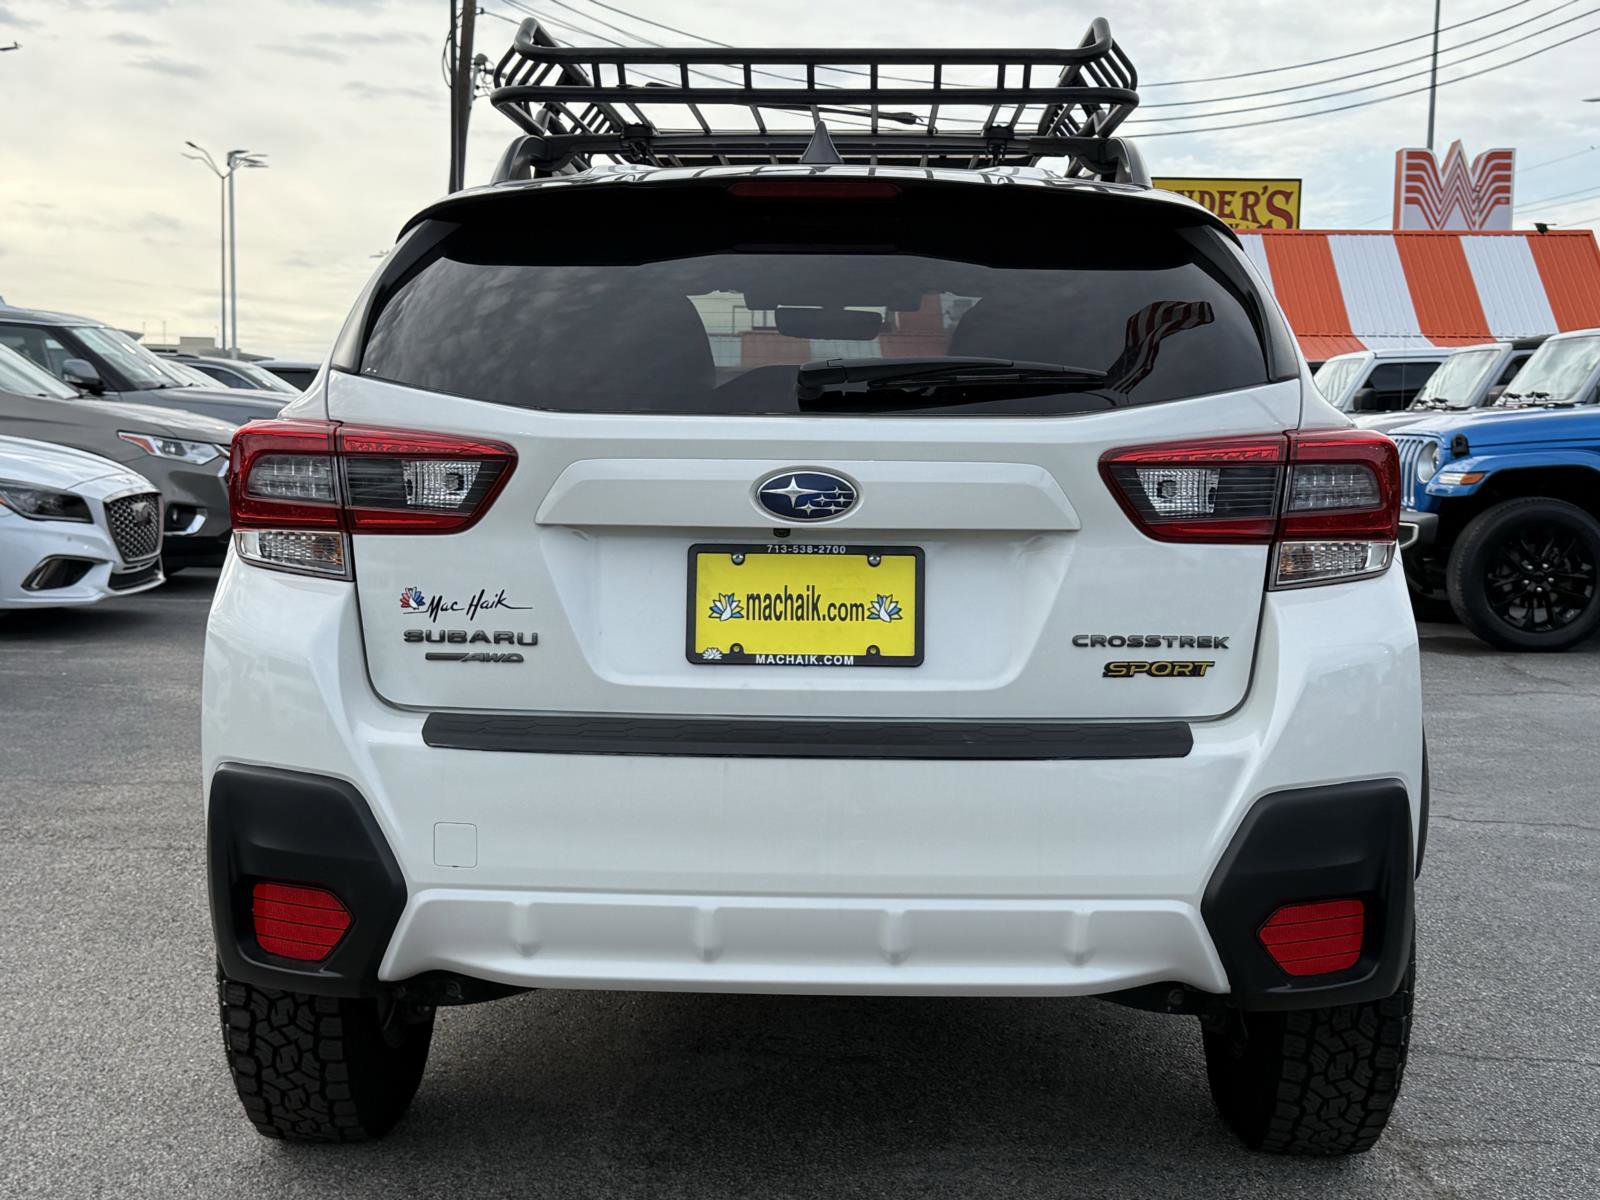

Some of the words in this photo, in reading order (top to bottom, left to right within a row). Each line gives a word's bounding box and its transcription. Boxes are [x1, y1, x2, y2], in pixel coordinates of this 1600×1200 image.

[766, 544, 847, 554] 713-538-2700
[418, 595, 465, 623] Mac
[466, 589, 526, 621] Haik
[745, 585, 865, 622] machaik.com
[403, 629, 539, 646] SUBARU
[1071, 634, 1230, 650] CROSSTREK
[460, 652, 525, 664] AWD
[755, 654, 855, 666] MACHAIK.COM
[1102, 660, 1216, 678] SPORT
